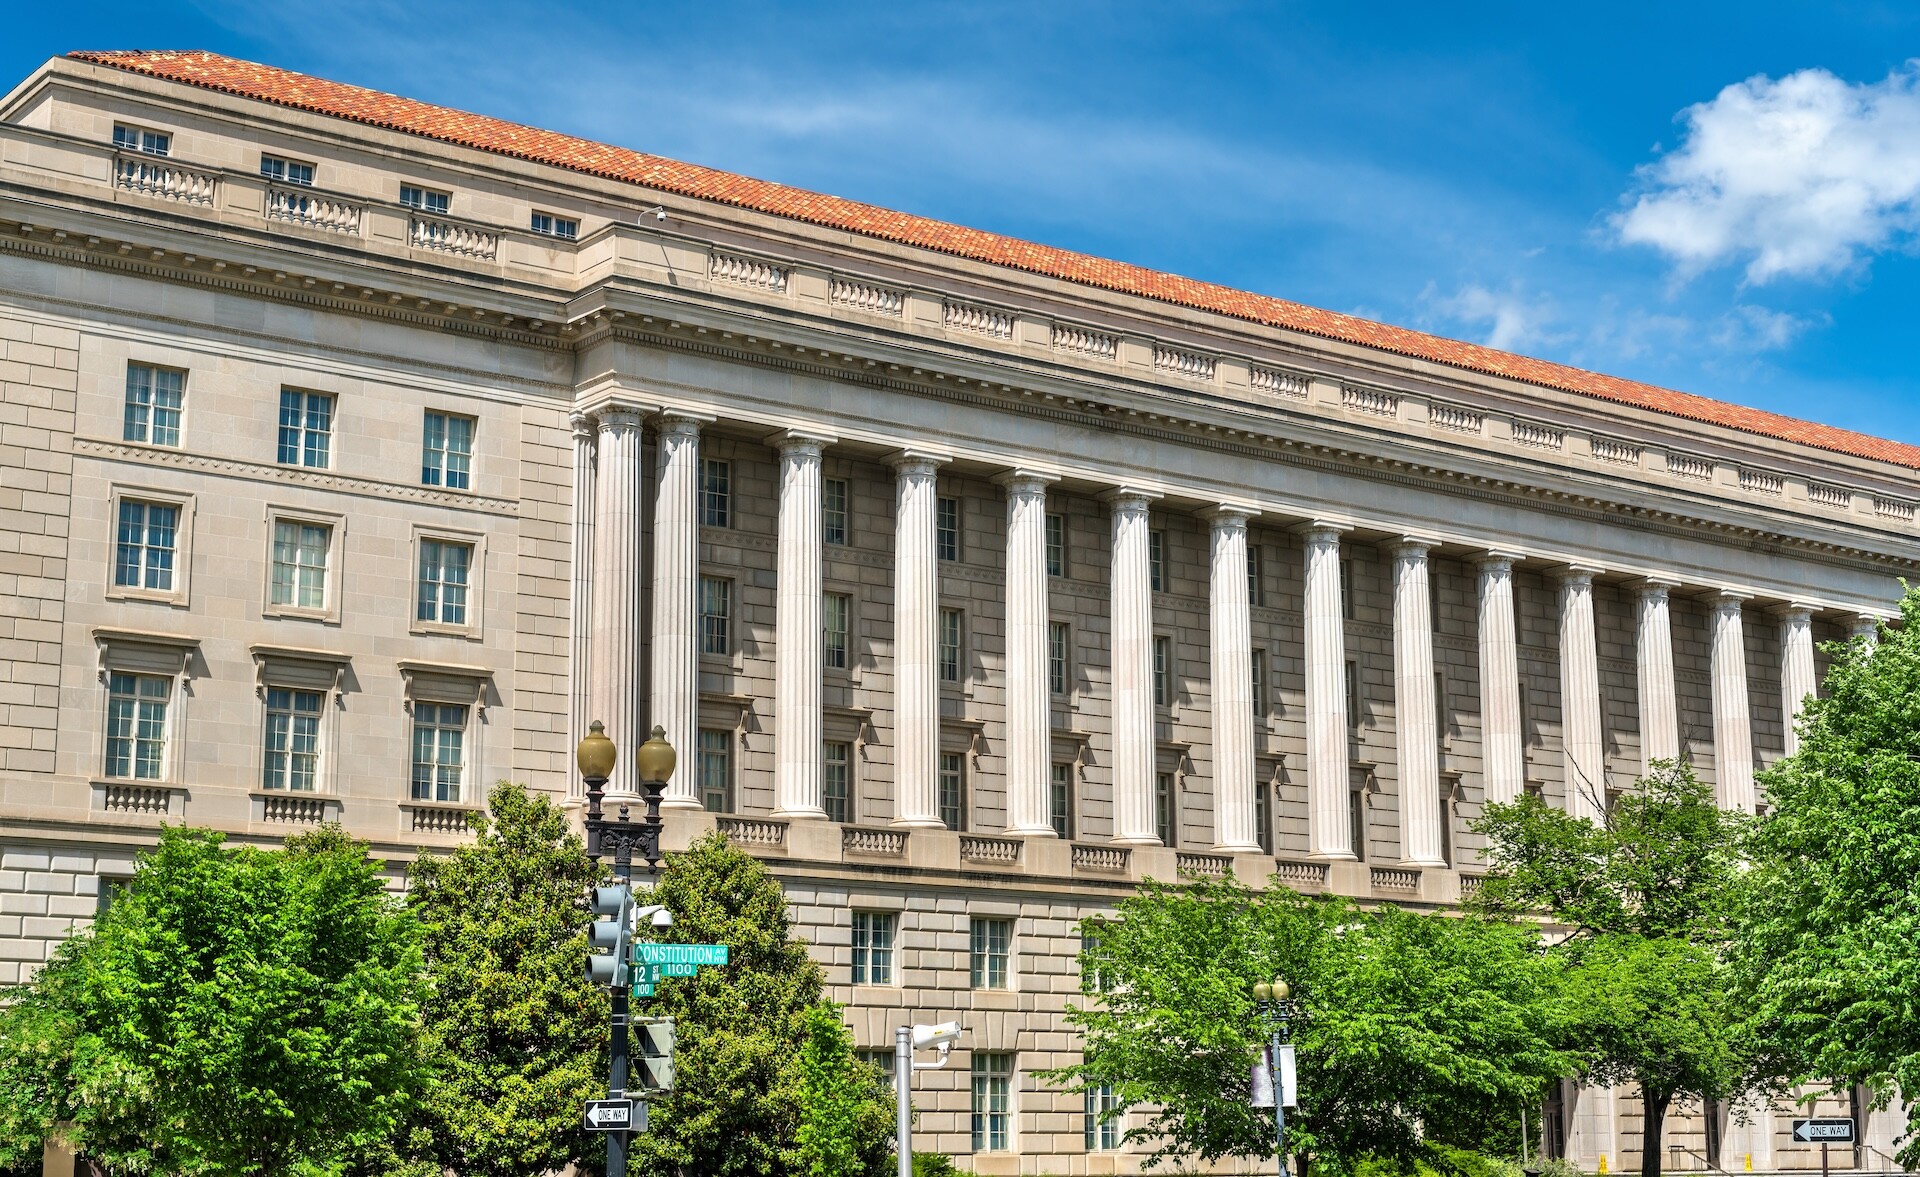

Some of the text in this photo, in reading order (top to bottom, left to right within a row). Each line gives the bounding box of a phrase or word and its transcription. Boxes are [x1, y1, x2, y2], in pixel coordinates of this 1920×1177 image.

[636, 946, 727, 962] CONSTITUTION AV
[633, 965, 659, 982] 12 ST
[667, 964, 692, 975] 1100
[637, 984, 650, 995] 100
[598, 1109, 626, 1120] ONE WAY
[1810, 1126, 1847, 1135] ONE WAY
